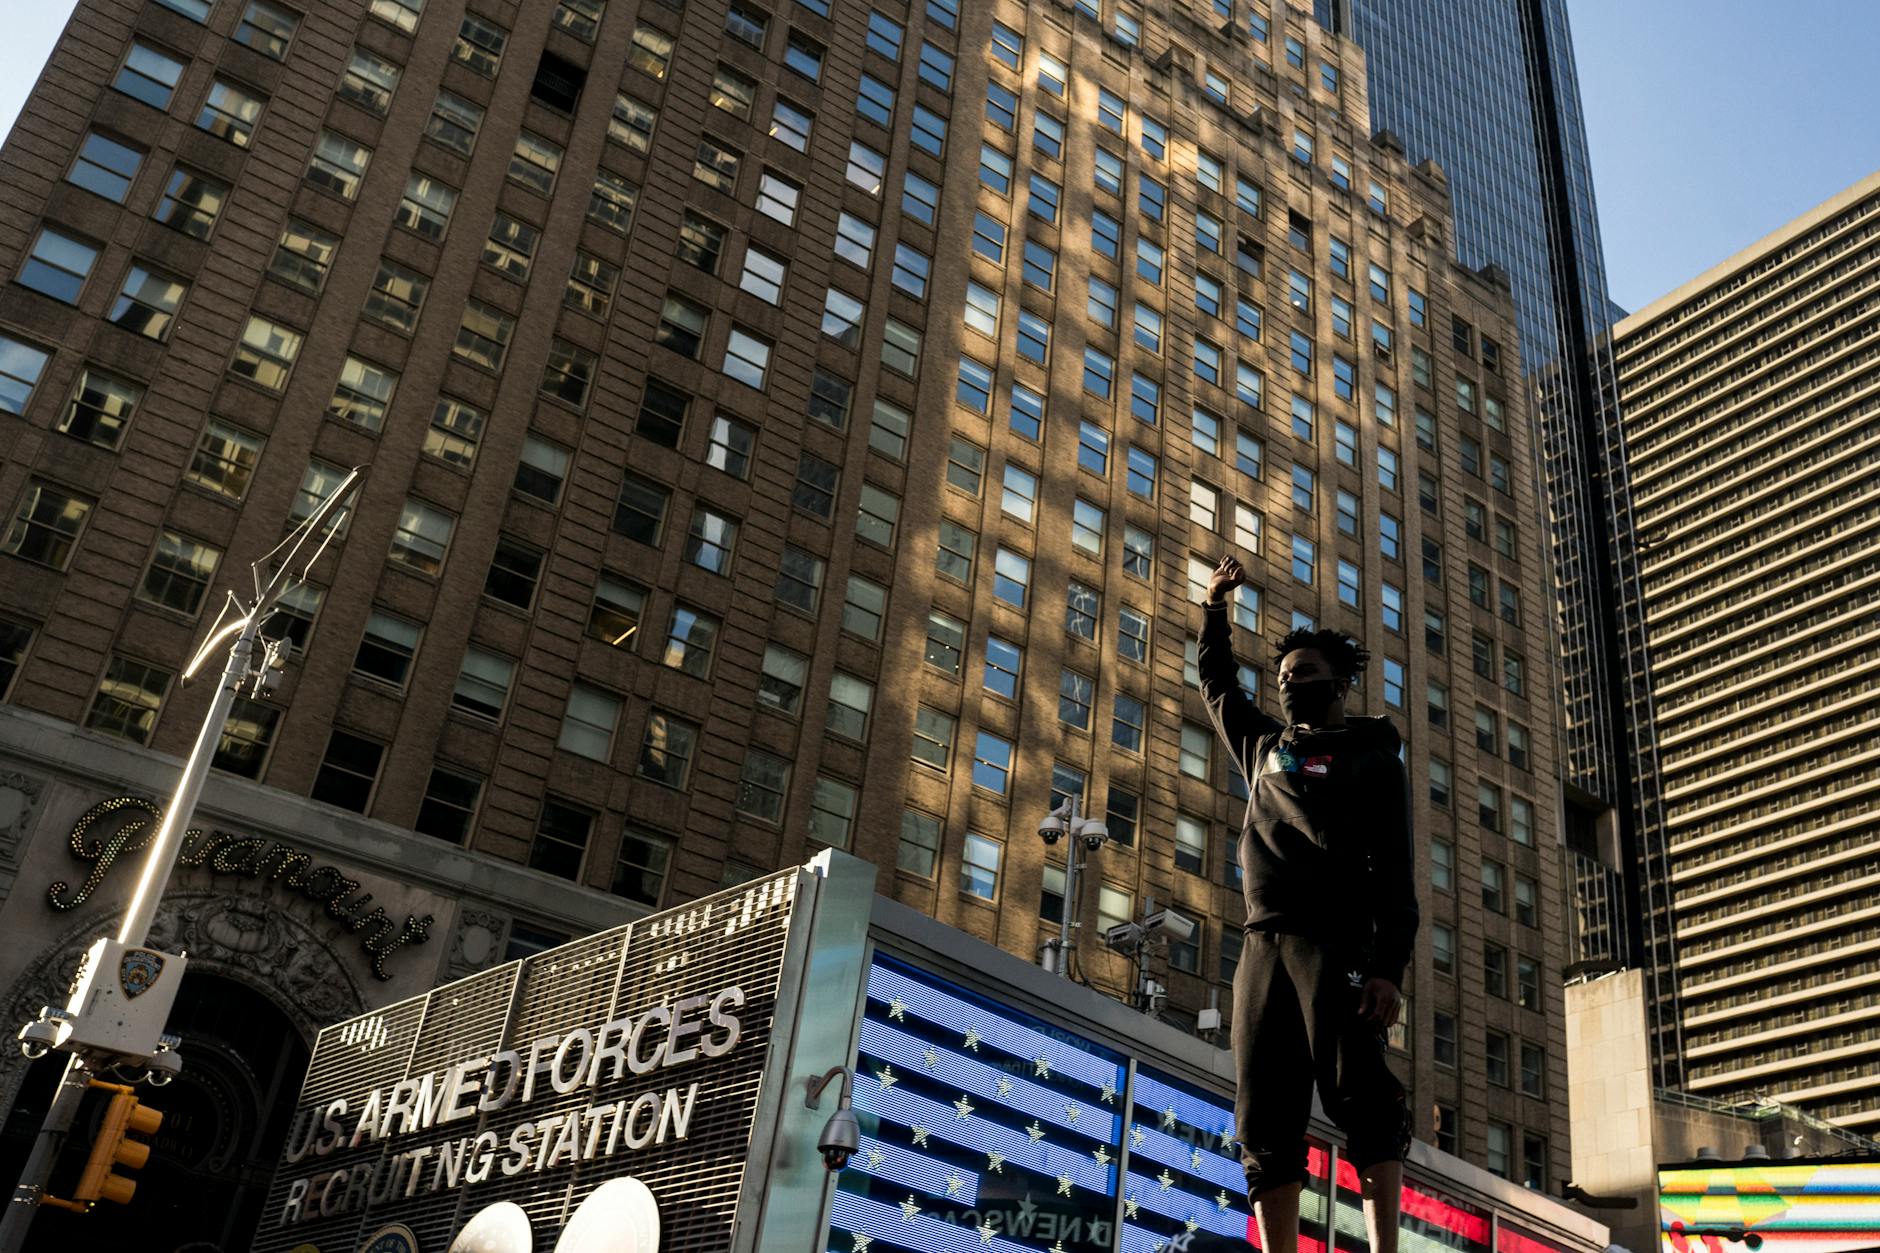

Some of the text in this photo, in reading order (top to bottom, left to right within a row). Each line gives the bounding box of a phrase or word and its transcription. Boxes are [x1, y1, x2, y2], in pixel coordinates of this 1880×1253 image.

[280, 1082, 700, 1227] RECRUITNG STATION
[286, 985, 745, 1164] U.S. ARMED FORCES
